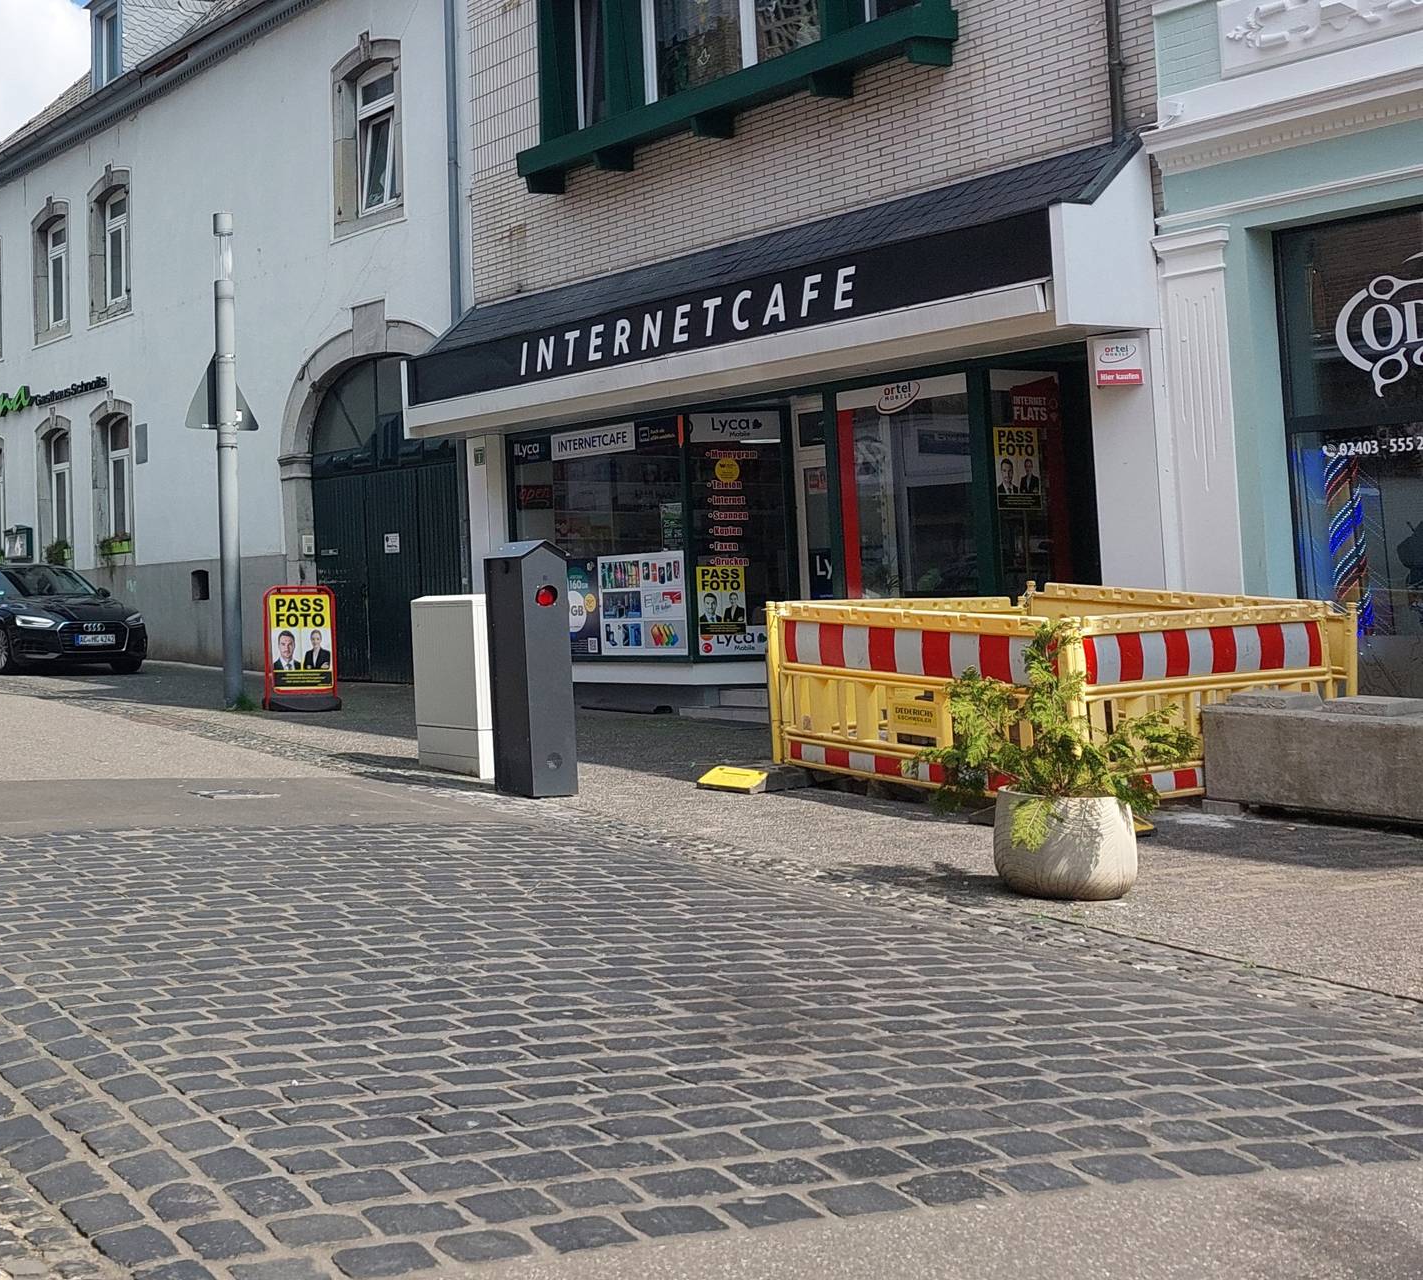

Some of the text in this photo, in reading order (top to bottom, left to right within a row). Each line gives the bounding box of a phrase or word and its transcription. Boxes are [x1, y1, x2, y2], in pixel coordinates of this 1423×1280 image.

[519, 265, 857, 376] INTERNETCAFE
[1116, 372, 1139, 380] kaufen
[884, 381, 911, 396] ortel
[1013, 395, 1047, 406] INTERNET
[1013, 406, 1048, 421] FLATS
[711, 416, 750, 434] Lyca
[557, 431, 627, 453] INTERNETCAFE
[998, 430, 1034, 443] PASS
[998, 443, 1035, 456] FOTO
[1339, 440, 1379, 456] 02403
[1389, 437, 1414, 452] 555
[710, 450, 758, 459] Moneygram
[713, 481, 742, 489] Telefon
[713, 496, 746, 505] Internet
[713, 511, 749, 520] Scannen
[713, 526, 743, 535] Kopien
[714, 541, 739, 551] Faxen
[701, 568, 740, 579] PASS
[701, 580, 741, 591] FOTO
[275, 598, 324, 612] PASS
[570, 605, 584, 616] GB
[275, 613, 325, 627] FOTO
